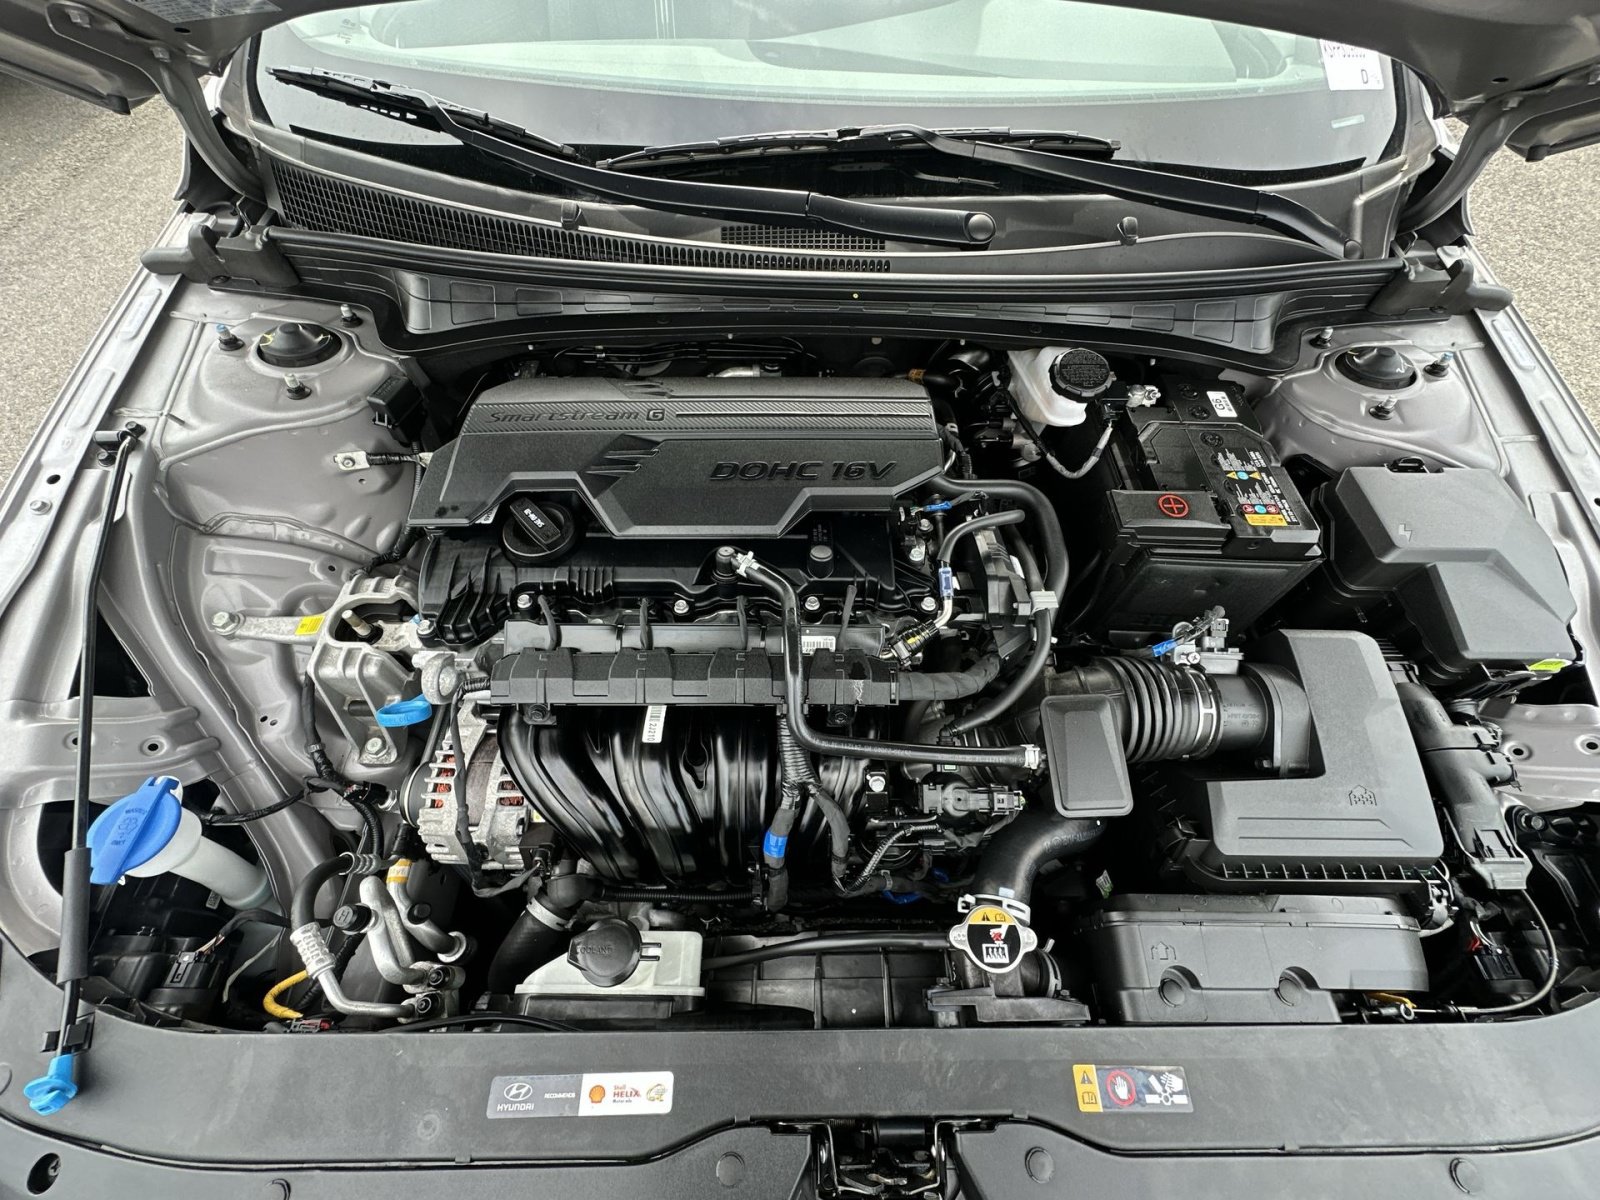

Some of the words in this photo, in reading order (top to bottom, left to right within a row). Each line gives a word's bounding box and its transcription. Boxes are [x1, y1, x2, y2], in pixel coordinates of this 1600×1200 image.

[1213, 398, 1225, 411] G6
[486, 410, 639, 424] Smartstream
[646, 409, 665, 421] G
[709, 460, 824, 481] DOHC
[831, 460, 898, 481] 16V
[613, 1088, 640, 1098] HELIX
[497, 1103, 535, 1112] HYUNDAI
